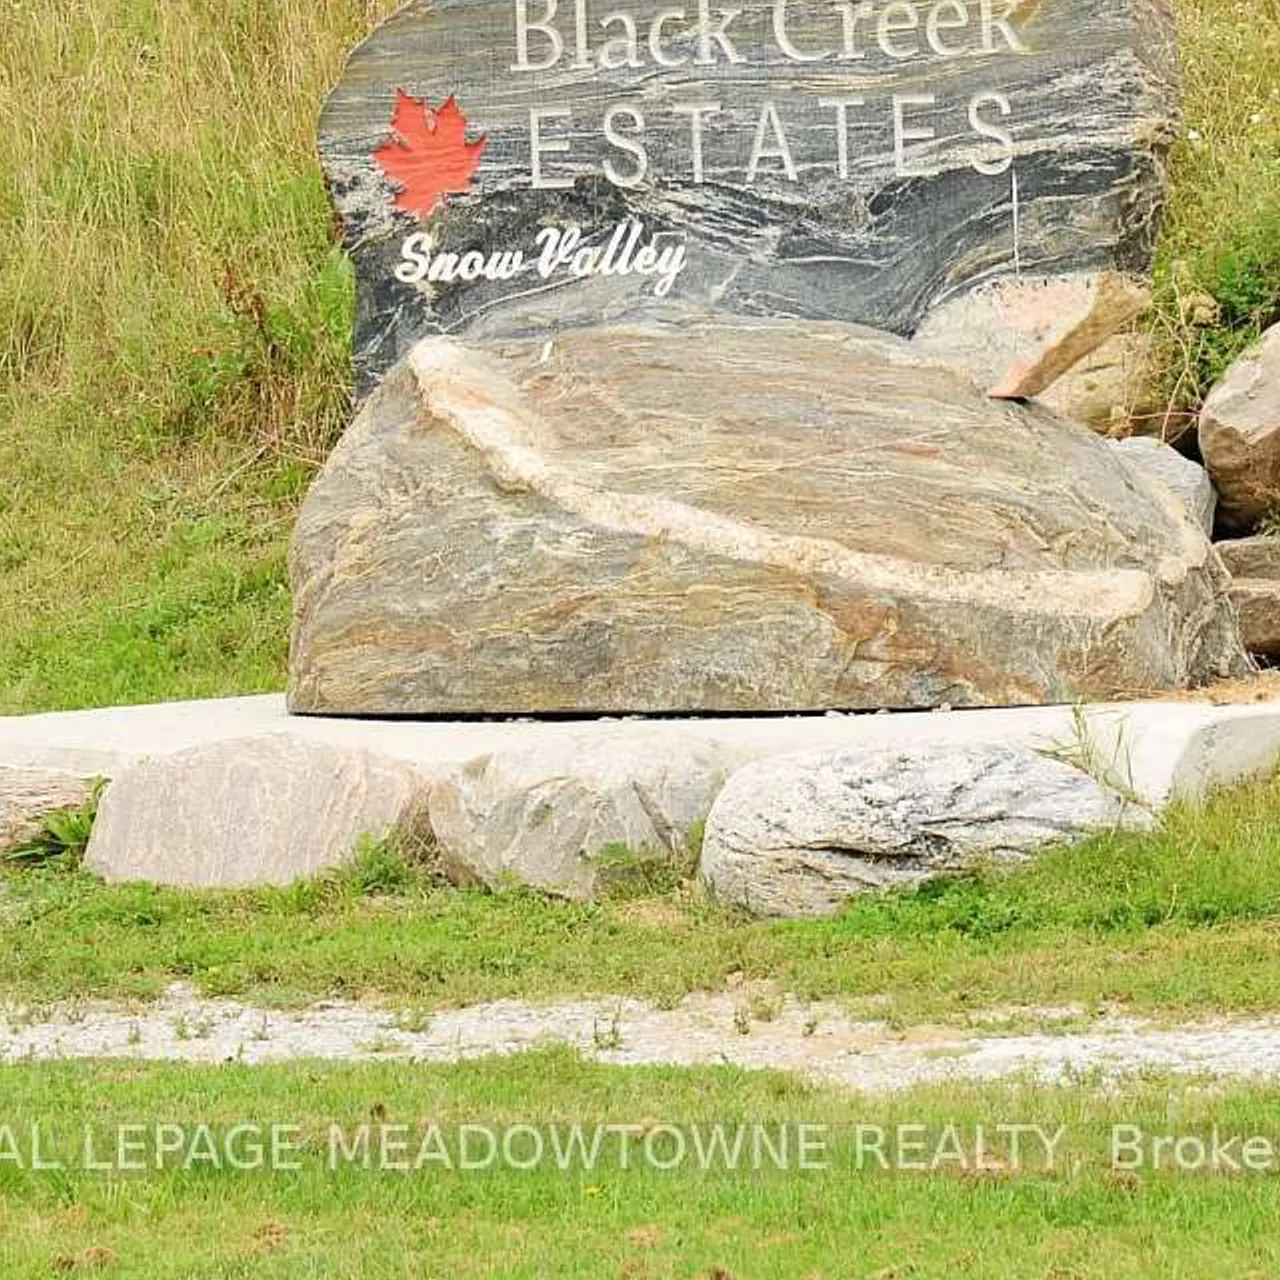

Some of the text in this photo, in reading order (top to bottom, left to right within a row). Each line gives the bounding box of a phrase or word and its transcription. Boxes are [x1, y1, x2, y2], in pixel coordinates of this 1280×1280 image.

[529, 92, 1014, 190] ESTATES
[394, 221, 687, 297] Snow Valley
